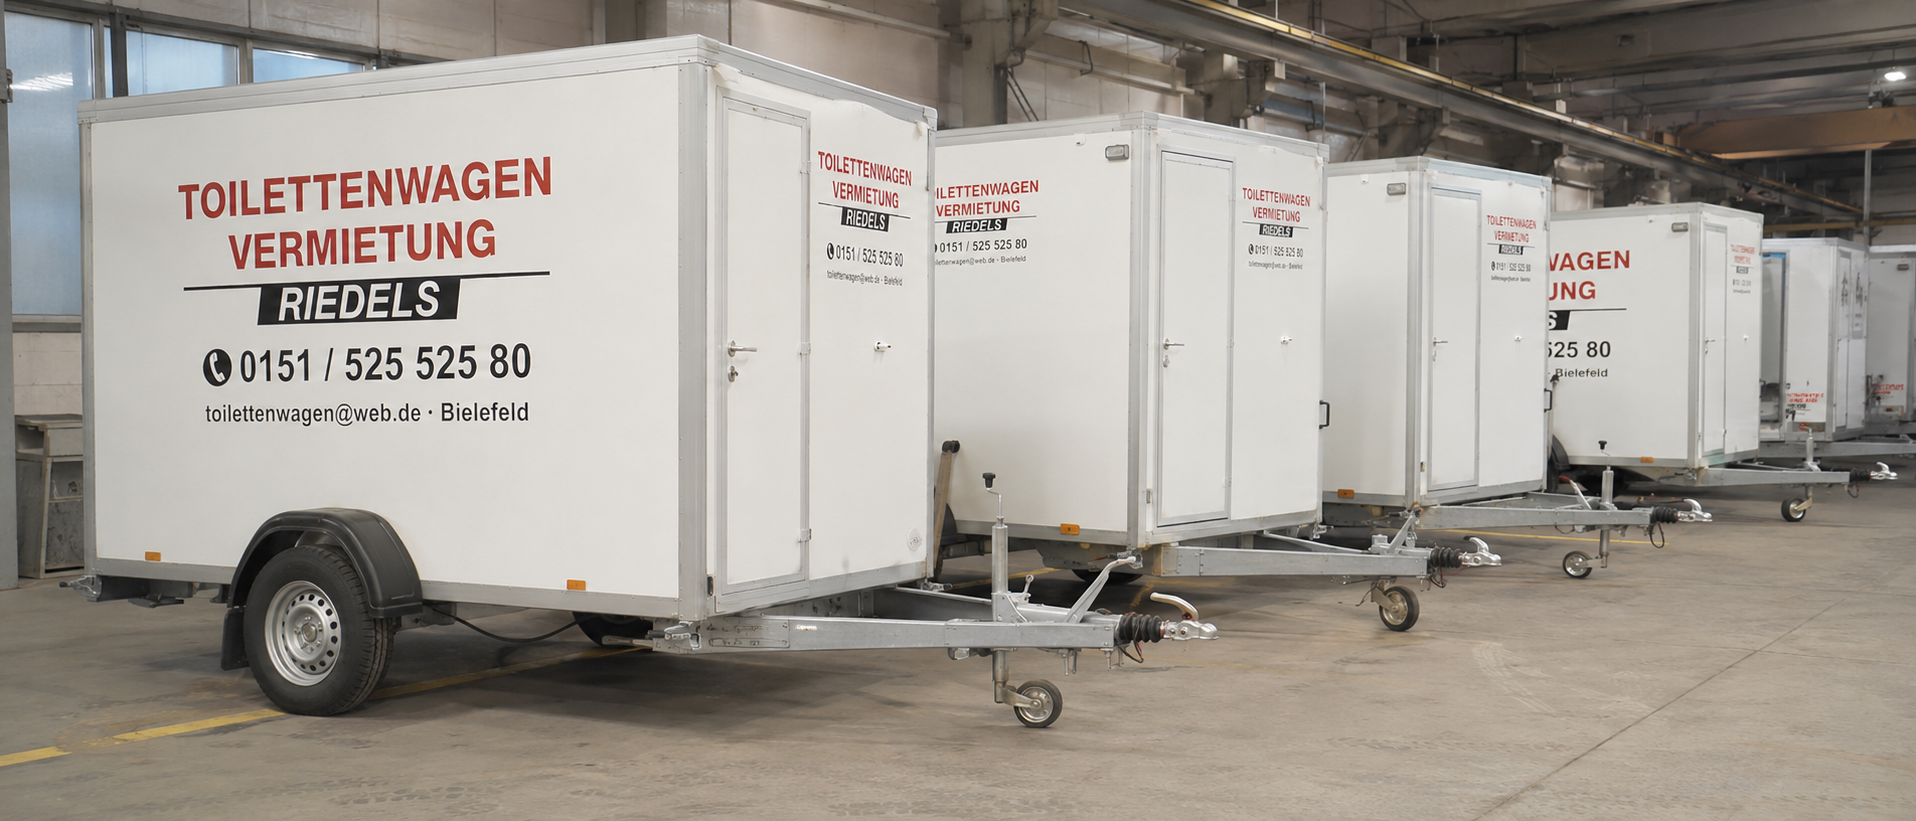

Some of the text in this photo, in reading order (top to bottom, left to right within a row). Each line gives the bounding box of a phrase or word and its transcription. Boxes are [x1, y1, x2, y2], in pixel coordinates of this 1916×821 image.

[818, 151, 912, 187] TOILETTENWAGEN
[178, 156, 552, 220] TOILETTENWAGEN
[832, 181, 899, 209] VERMIETUNG
[935, 179, 1039, 200] ILETTENWAGEN
[1242, 187, 1311, 207] TOILETTENWAGEN
[936, 200, 1020, 217] VERMIETUNG
[845, 209, 886, 230] RIEDELS
[952, 218, 1002, 233] RIEDELS
[228, 219, 496, 270] VERMIETUNG
[836, 244, 855, 261] 0151
[862, 248, 877, 264] 525
[879, 250, 893, 266] 525
[940, 241, 963, 253] 0151
[972, 240, 991, 251] 525
[994, 239, 1012, 250] 525
[1015, 238, 1028, 249] 80
[278, 280, 441, 321] RIEDELS
[1586, 341, 1611, 358] 80
[240, 343, 532, 382] 0151 / 525 525 80
[1555, 368, 1608, 378] Bielefeld
[205, 403, 421, 426] toilettenwagen@web.de
[441, 402, 529, 422] Bielefeld
